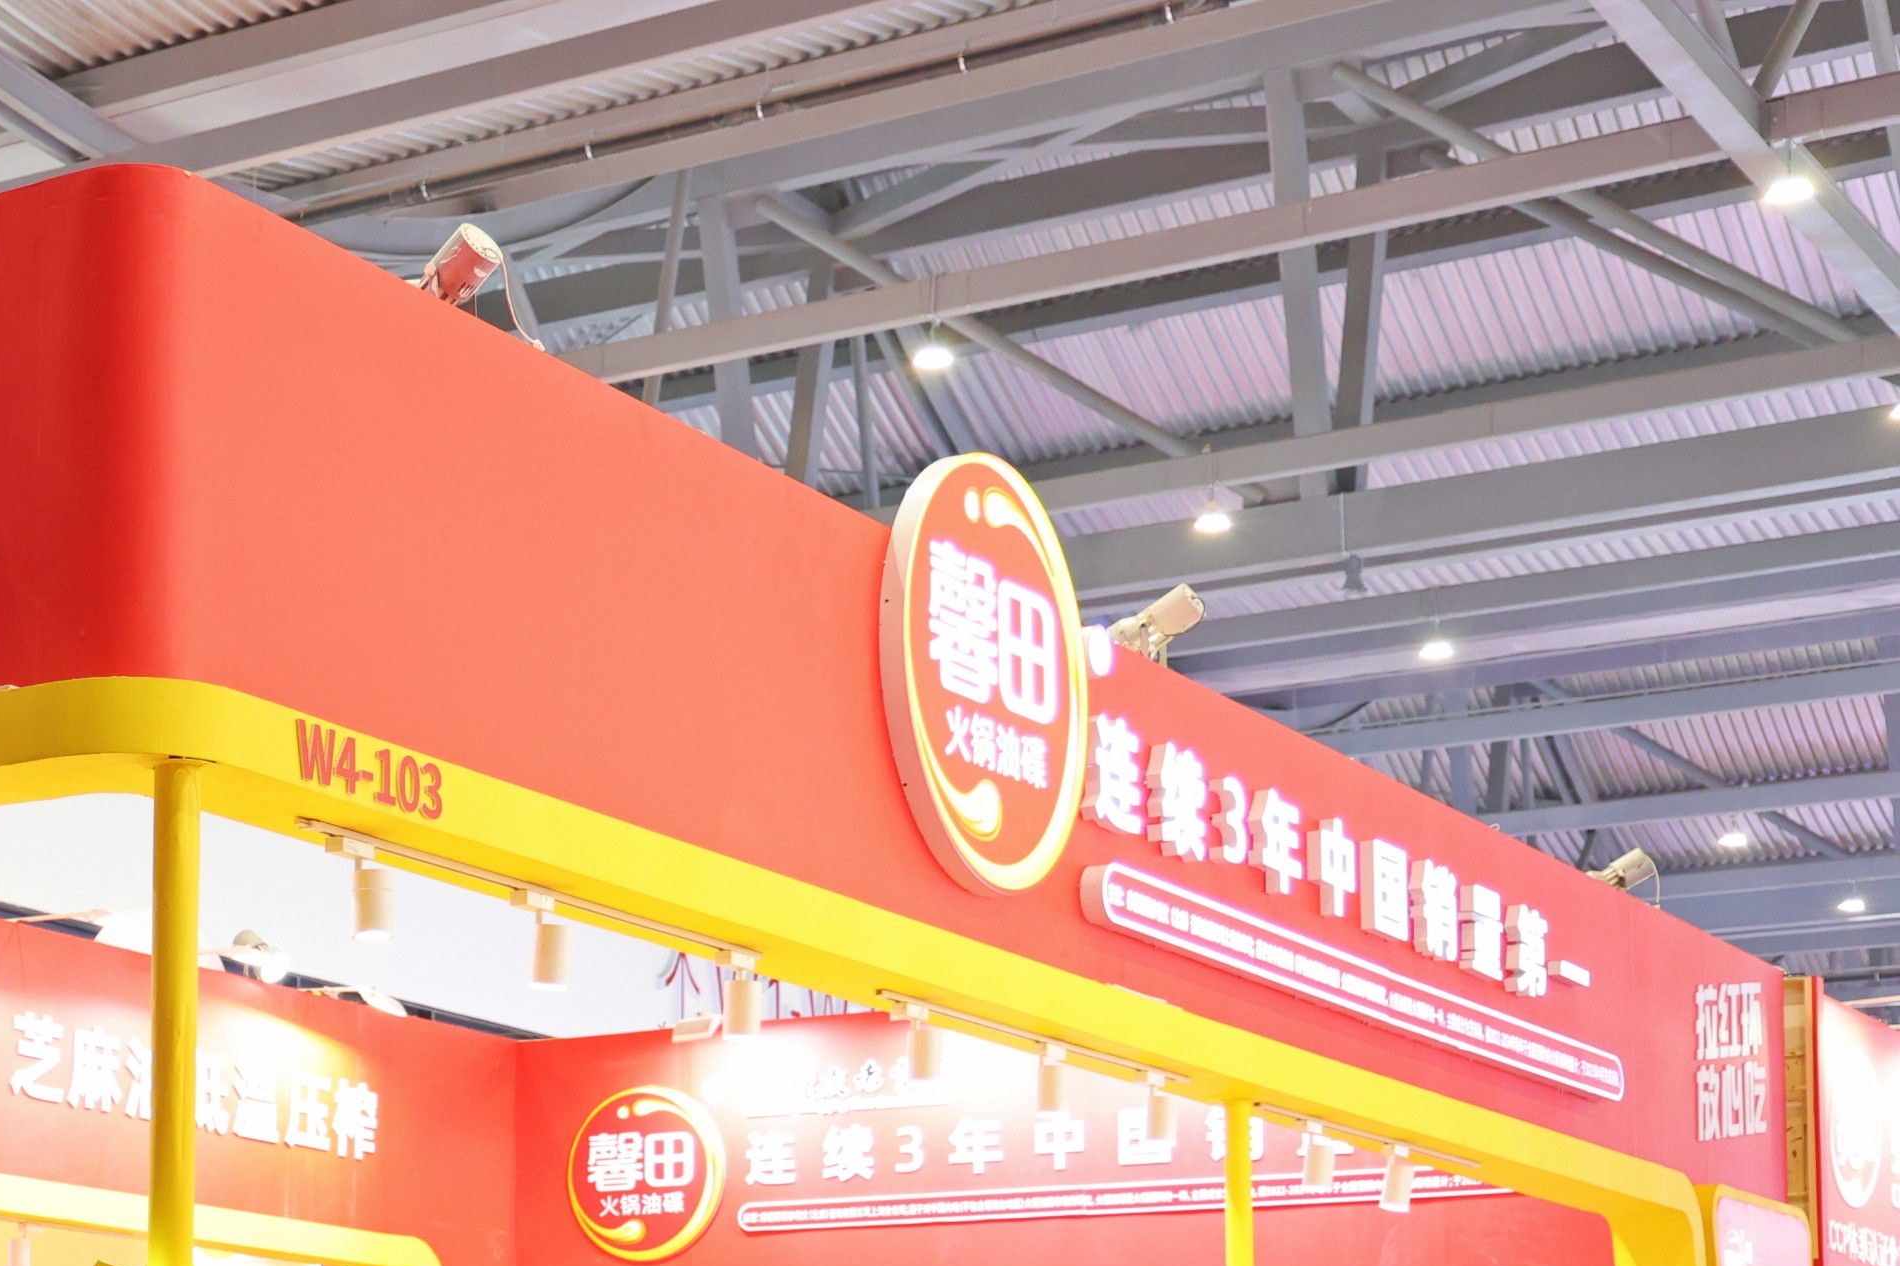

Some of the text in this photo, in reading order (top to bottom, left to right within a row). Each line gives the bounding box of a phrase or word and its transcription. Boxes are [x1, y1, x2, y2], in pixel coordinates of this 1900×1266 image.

[928, 540, 1056, 724] 馨田
[295, 718, 443, 820] W4-103
[944, 704, 1048, 790] 火锅油碟
[1086, 714, 1593, 997] 连续3年中国销量第一
[1696, 1062, 1768, 1142] 放心吃
[586, 1131, 695, 1192] 馨田
[598, 1192, 685, 1217] 火锅油碟
